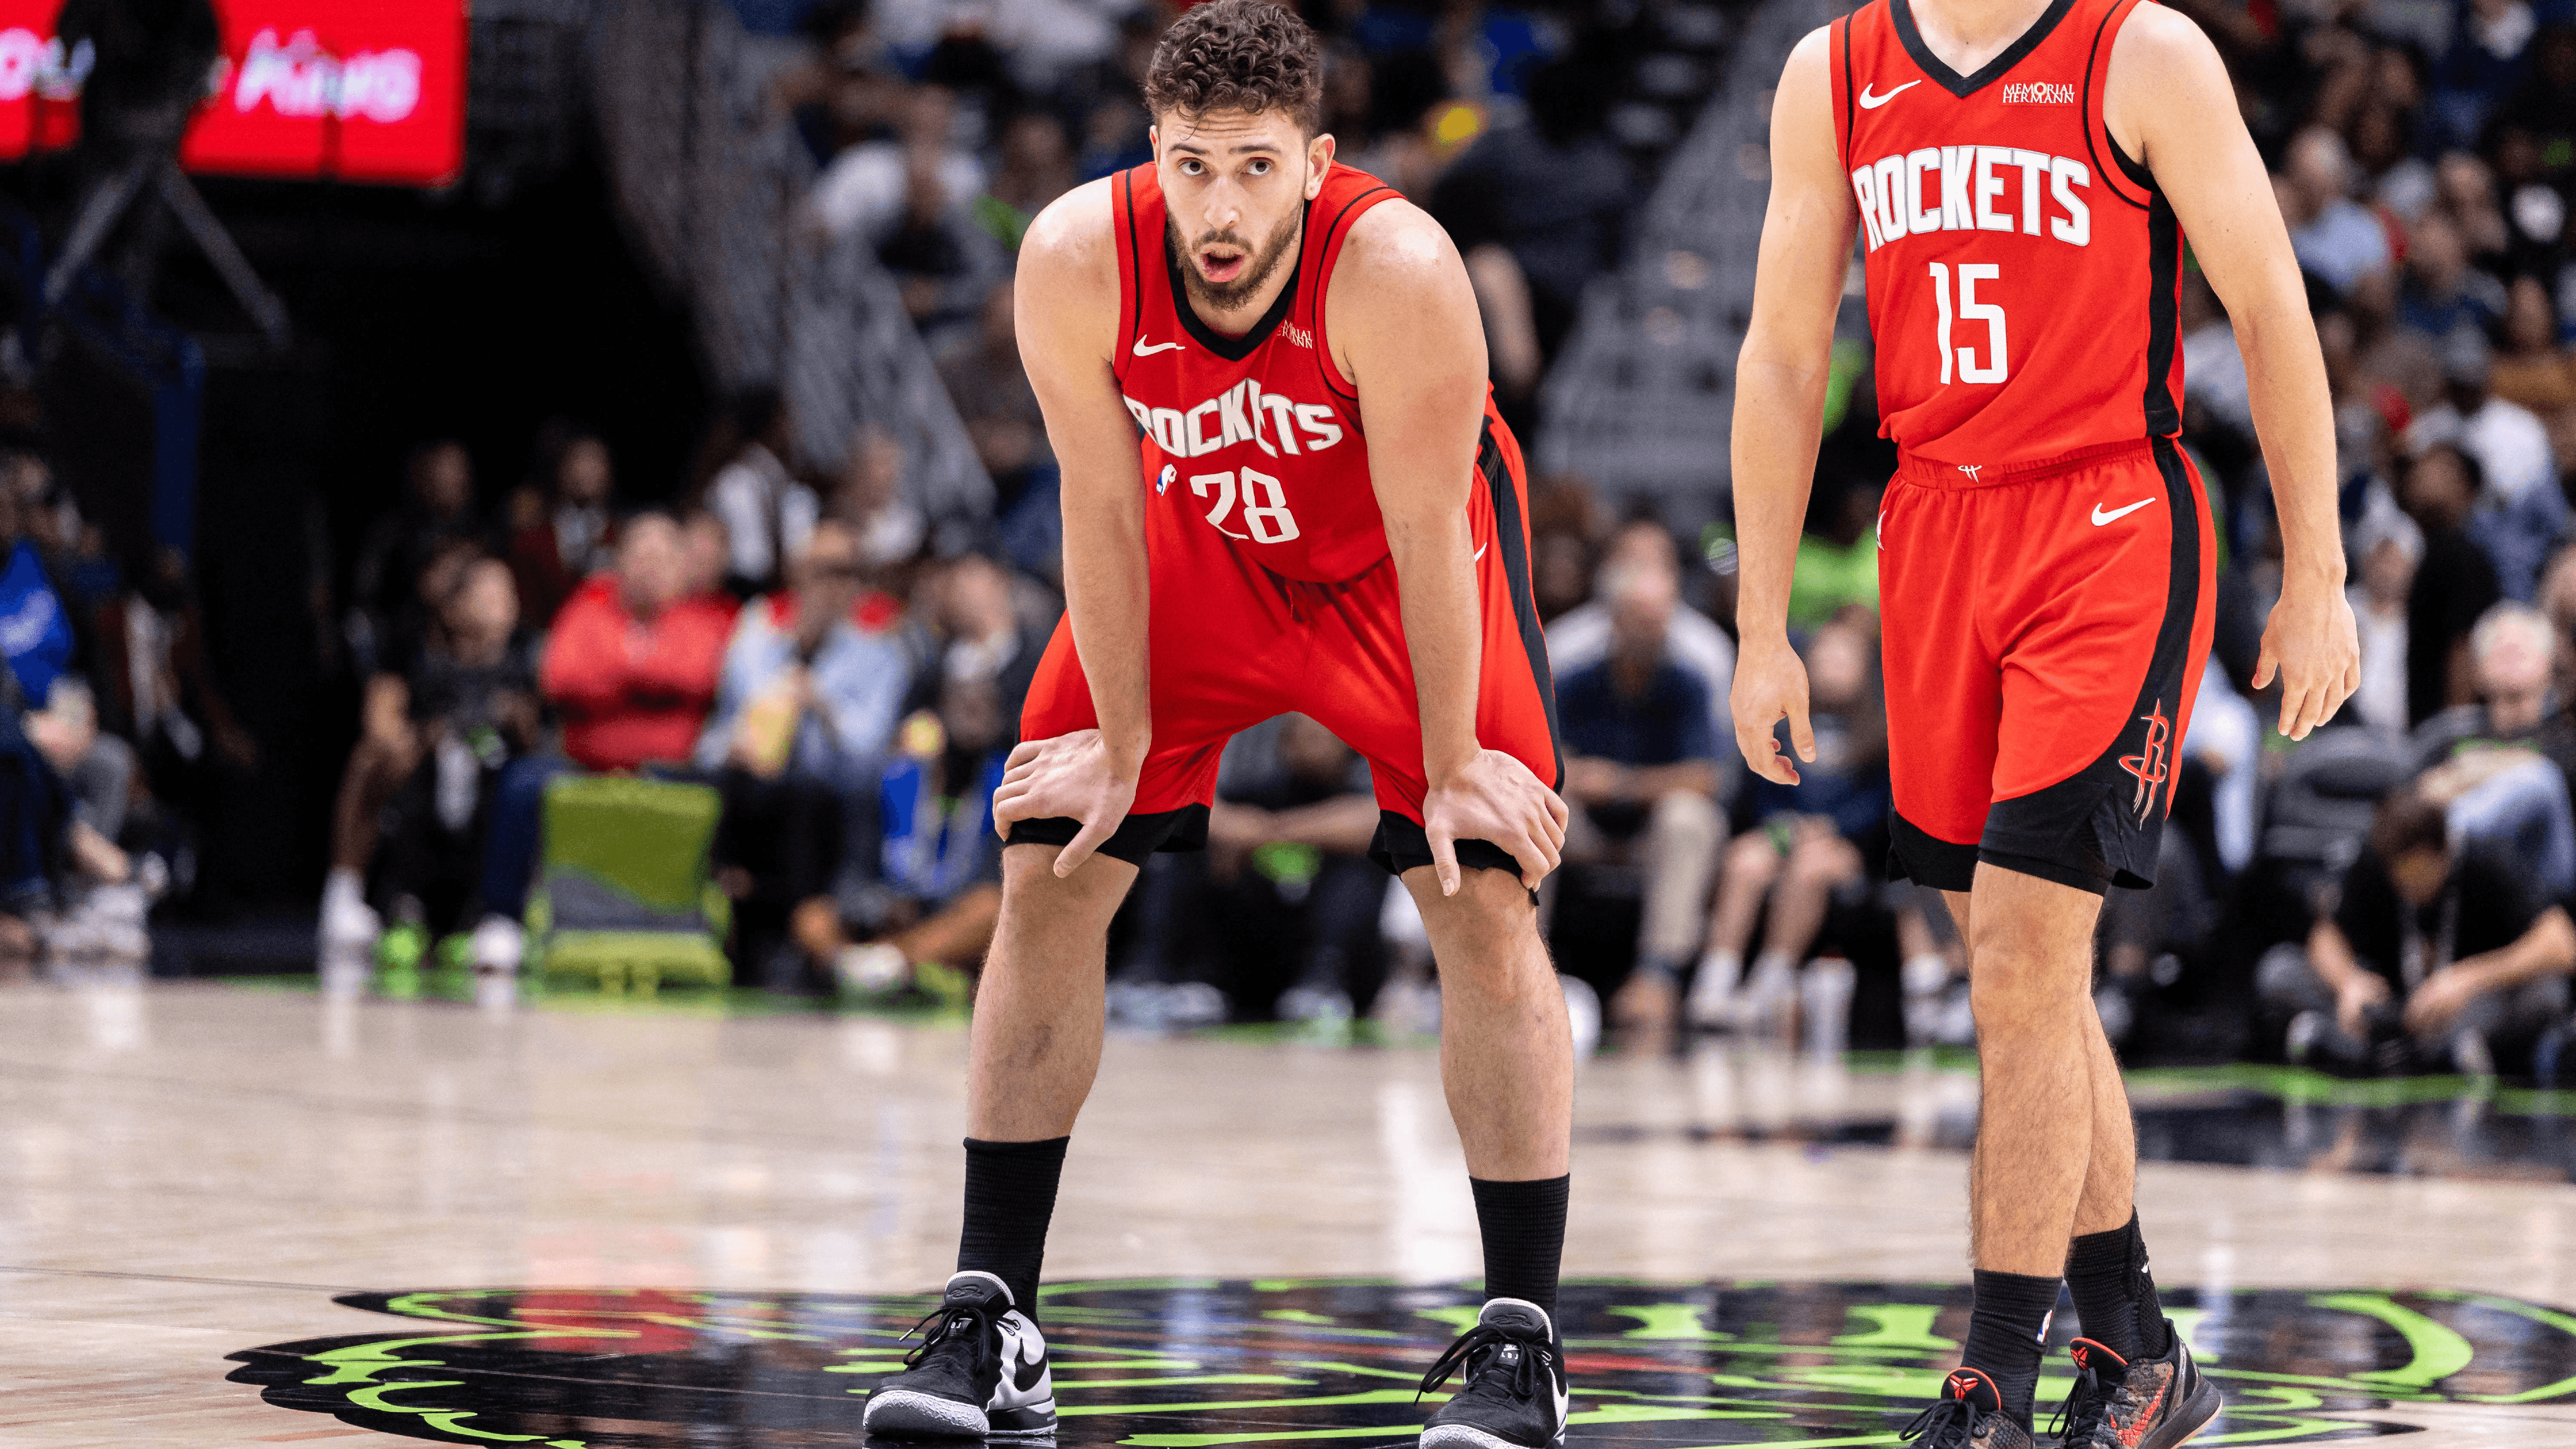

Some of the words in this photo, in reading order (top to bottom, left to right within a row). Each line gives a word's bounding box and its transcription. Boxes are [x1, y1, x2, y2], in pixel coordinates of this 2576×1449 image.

[2002, 92, 2074, 104] HERMANN
[2003, 81, 2075, 94] MEMORIAL
[1852, 145, 2090, 253] ROCKETS
[1928, 262, 2008, 386] 15
[1189, 465, 1301, 544] 28
